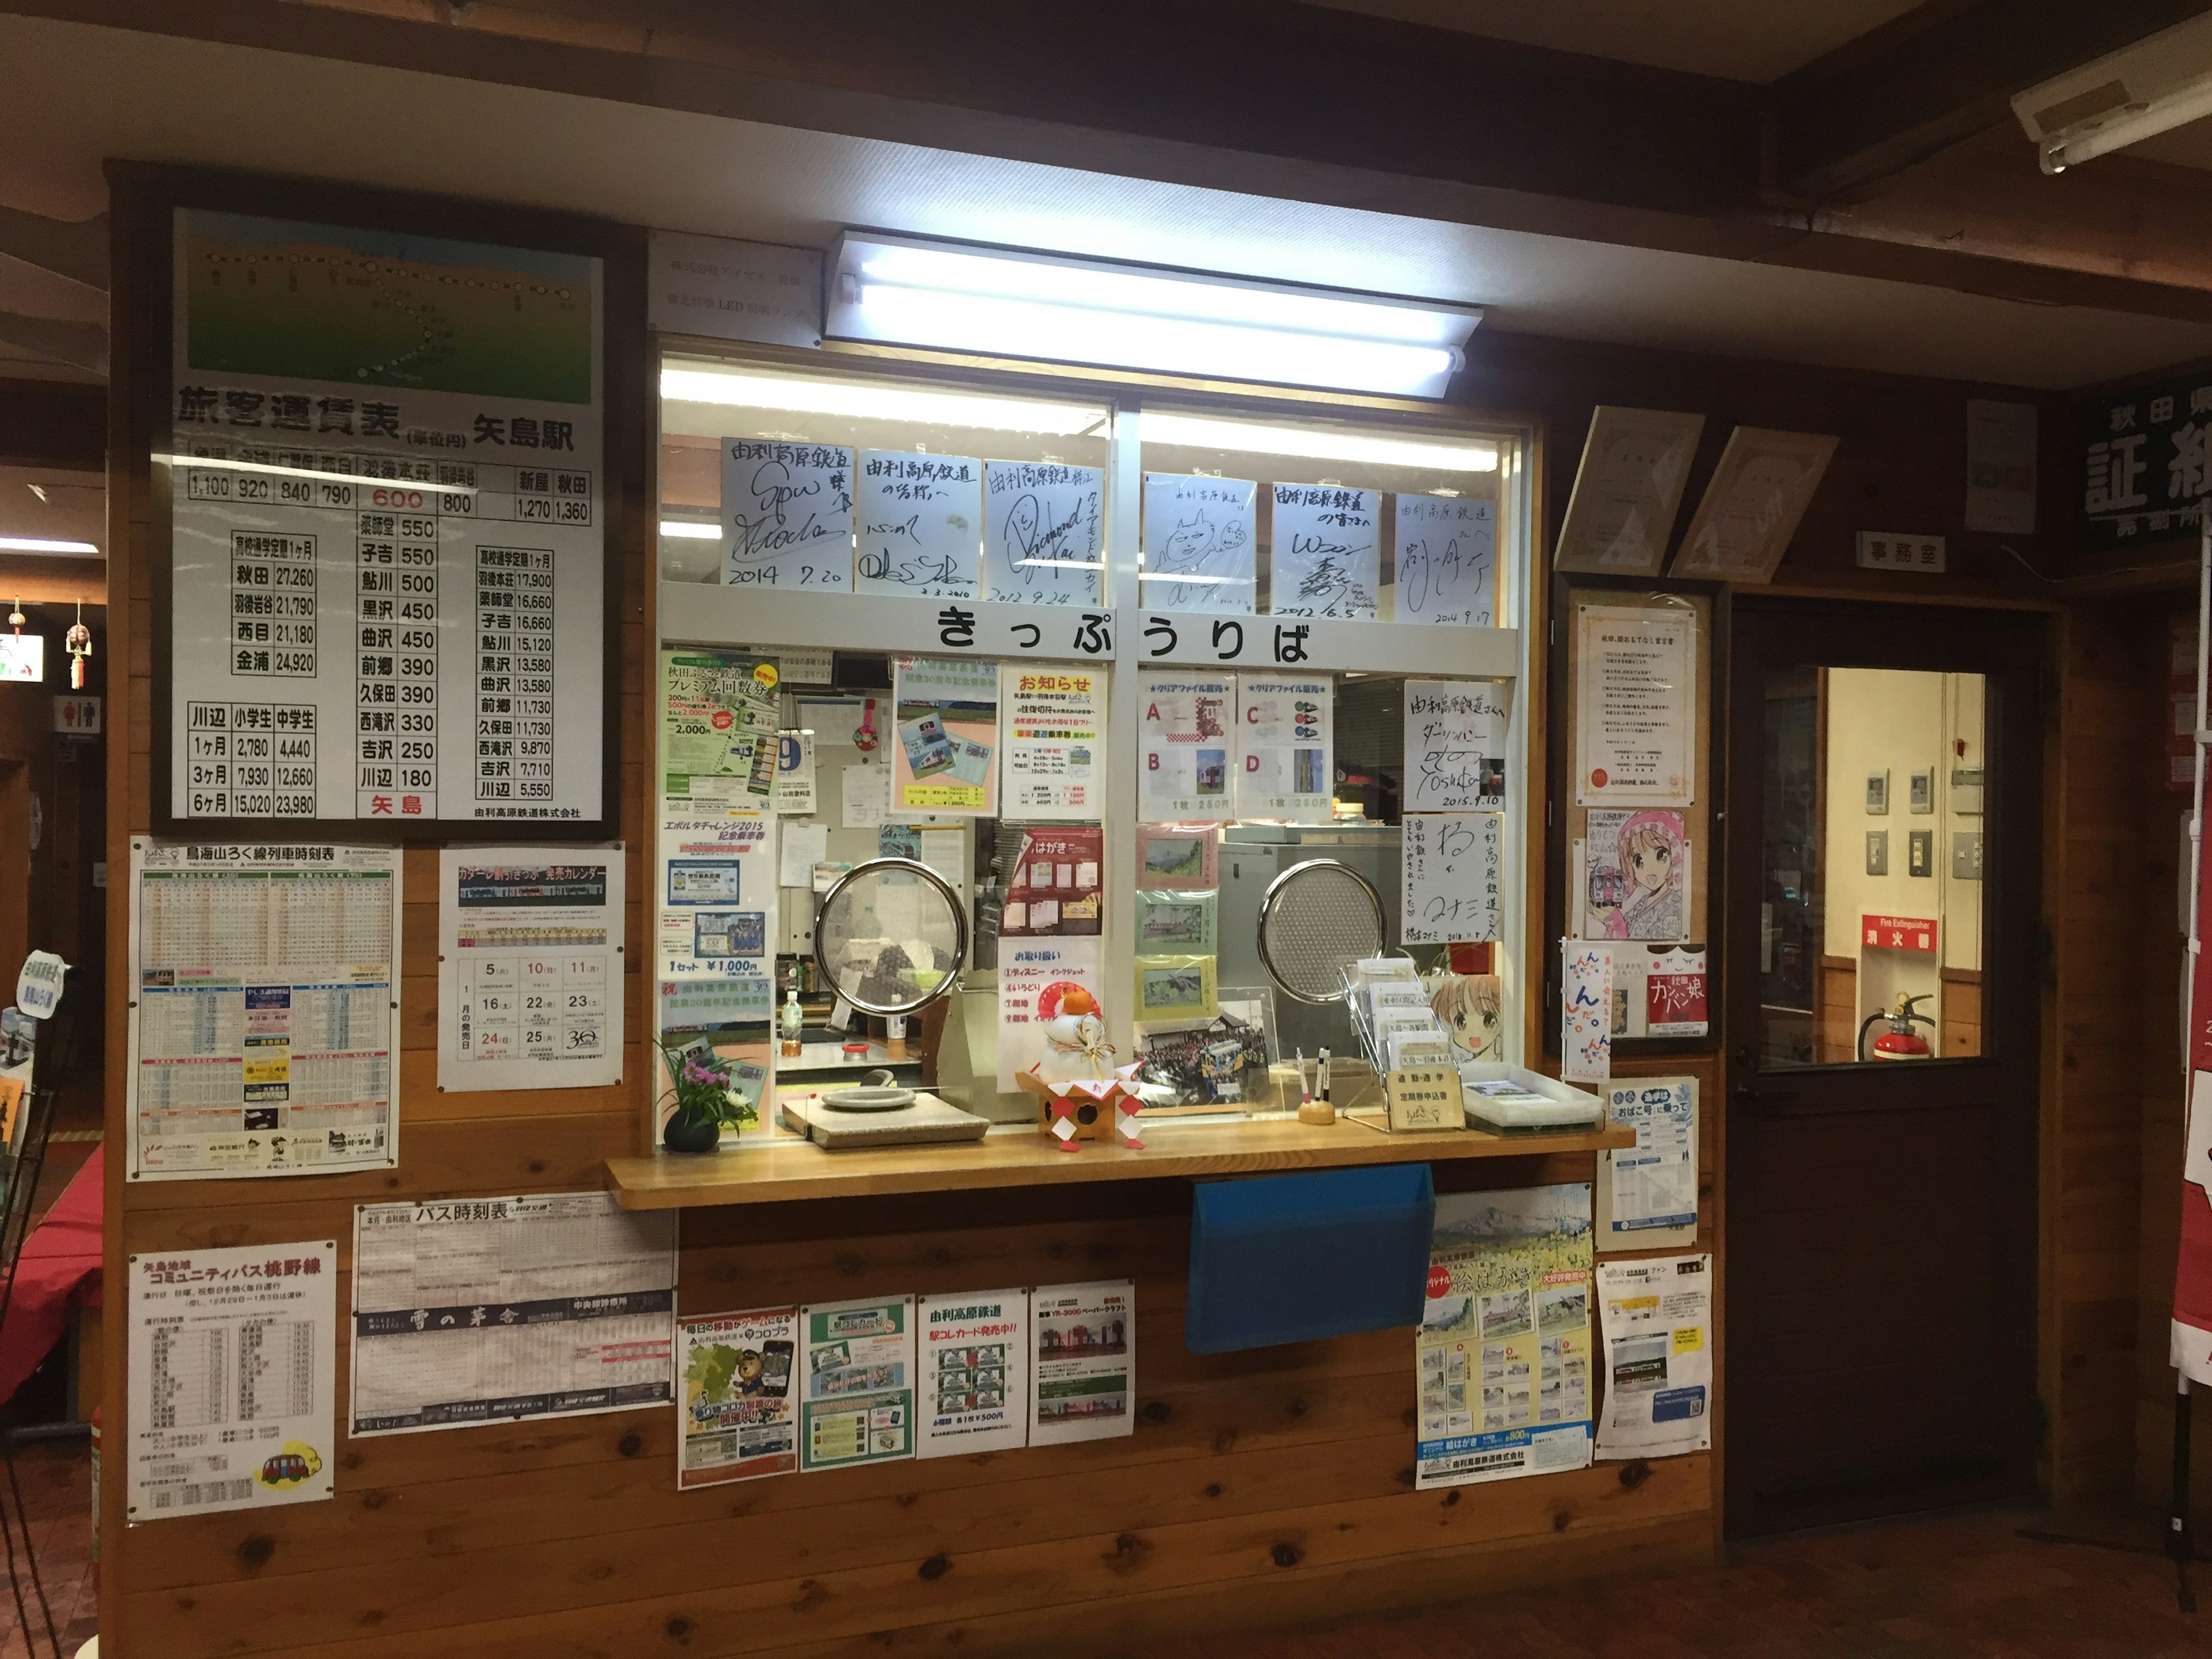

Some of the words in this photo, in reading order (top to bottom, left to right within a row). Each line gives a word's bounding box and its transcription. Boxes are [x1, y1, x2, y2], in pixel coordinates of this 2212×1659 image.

[177, 387, 400, 440] 旅客運賃表
[473, 414, 574, 452] 矢島駅
[520, 470, 549, 493] 新屋
[558, 473, 587, 494] 秋田
[192, 475, 229, 496] 1,100
[238, 478, 268, 499] 920
[281, 482, 310, 502] 840
[321, 484, 351, 505] 790
[372, 489, 424, 509] 600
[443, 493, 472, 513] 800
[518, 498, 551, 519] 1,270
[555, 501, 588, 521] 1,360
[361, 514, 394, 536] 薬師堂
[402, 520, 434, 538] 550
[362, 543, 392, 565] 子吉
[402, 548, 434, 566] 550
[237, 565, 269, 586] 秋田
[276, 567, 314, 588] 27,260
[362, 571, 392, 592] 鮎川
[402, 575, 434, 593] 500
[517, 574, 551, 589] 17,900
[728, 566, 779, 586] 2014
[479, 591, 513, 608] 薬師堂
[517, 594, 551, 610] 16,660
[987, 589, 1022, 604] 2012
[276, 597, 314, 618] 21,790
[362, 599, 393, 621] 黒沢
[402, 603, 434, 620] 450
[481, 613, 512, 629] 子吉
[517, 615, 551, 631] 16,660
[237, 622, 269, 642] 西目
[276, 624, 314, 645] 21,180
[362, 628, 393, 649] 曲沢
[402, 631, 434, 649] 450
[482, 635, 511, 651] 鮎川
[517, 637, 551, 652] 15,120
[937, 605, 1310, 663] きっぷうりば
[237, 650, 269, 672] 金浦
[276, 652, 314, 674] 24,920
[362, 655, 392, 676] 前郷
[402, 658, 434, 676] 390
[481, 657, 511, 673] 黒沢
[517, 657, 551, 673] 13,580
[360, 683, 395, 704] 久保田
[402, 686, 434, 703] 390
[482, 677, 511, 692] 曲沢
[517, 678, 551, 694] 13,580
[668, 680, 767, 696] プレミアム回数券
[1020, 676, 1091, 692] お知らせ
[517, 699, 551, 715] 11,730
[1147, 702, 1161, 721] A
[1247, 706, 1258, 724] C
[193, 706, 226, 728] 川辺
[234, 708, 272, 729] 小学生
[277, 709, 314, 729] 中学生
[360, 711, 395, 732] 西滝沢
[402, 714, 434, 732] 330
[479, 719, 513, 736] 久保田
[517, 721, 551, 736] 11,730
[676, 724, 711, 734] 2,000円
[195, 736, 226, 756] 1ヶ月
[237, 738, 268, 758] 2,780
[279, 740, 310, 759] 4,440
[362, 740, 393, 760] 吉沢
[402, 742, 434, 760] 250
[479, 741, 513, 757] 西滝沢
[521, 741, 551, 757] 9,870
[481, 760, 511, 777] 吉沢
[521, 762, 551, 779] 7,710
[1148, 753, 1160, 771] B
[1246, 755, 1260, 772] D
[193, 765, 226, 785] 3ヶ月
[238, 767, 269, 788] 7,930
[277, 768, 313, 788] 12,660
[361, 767, 392, 788] 川辺
[402, 769, 431, 787] 180
[480, 781, 511, 797] 川辺
[521, 782, 551, 798] 5,550
[194, 793, 226, 813] 6ヶ月
[234, 794, 271, 815] 15,020
[276, 796, 314, 816] 23,980
[372, 794, 422, 815] 矢島
[1442, 796, 1499, 806] 2015.9.10
[474, 807, 581, 819] 由利高原鉄道株式会社
[186, 846, 335, 862] 鳥海山ろく線列車時刻表
[545, 867, 606, 881] 発売カレンダー
[1880, 918, 1893, 928] Fire
[1893, 918, 1930, 930] Extinguisher
[1867, 929, 1929, 949] 消火器
[1014, 950, 1061, 961] お取り扱い
[416, 1202, 509, 1222] バス時刻表
[150, 1257, 321, 1285] コミュニティバス桃野線
[1452, 1267, 1532, 1293] 絵はがき
[930, 1304, 1002, 1323] 由利高原鉄道
